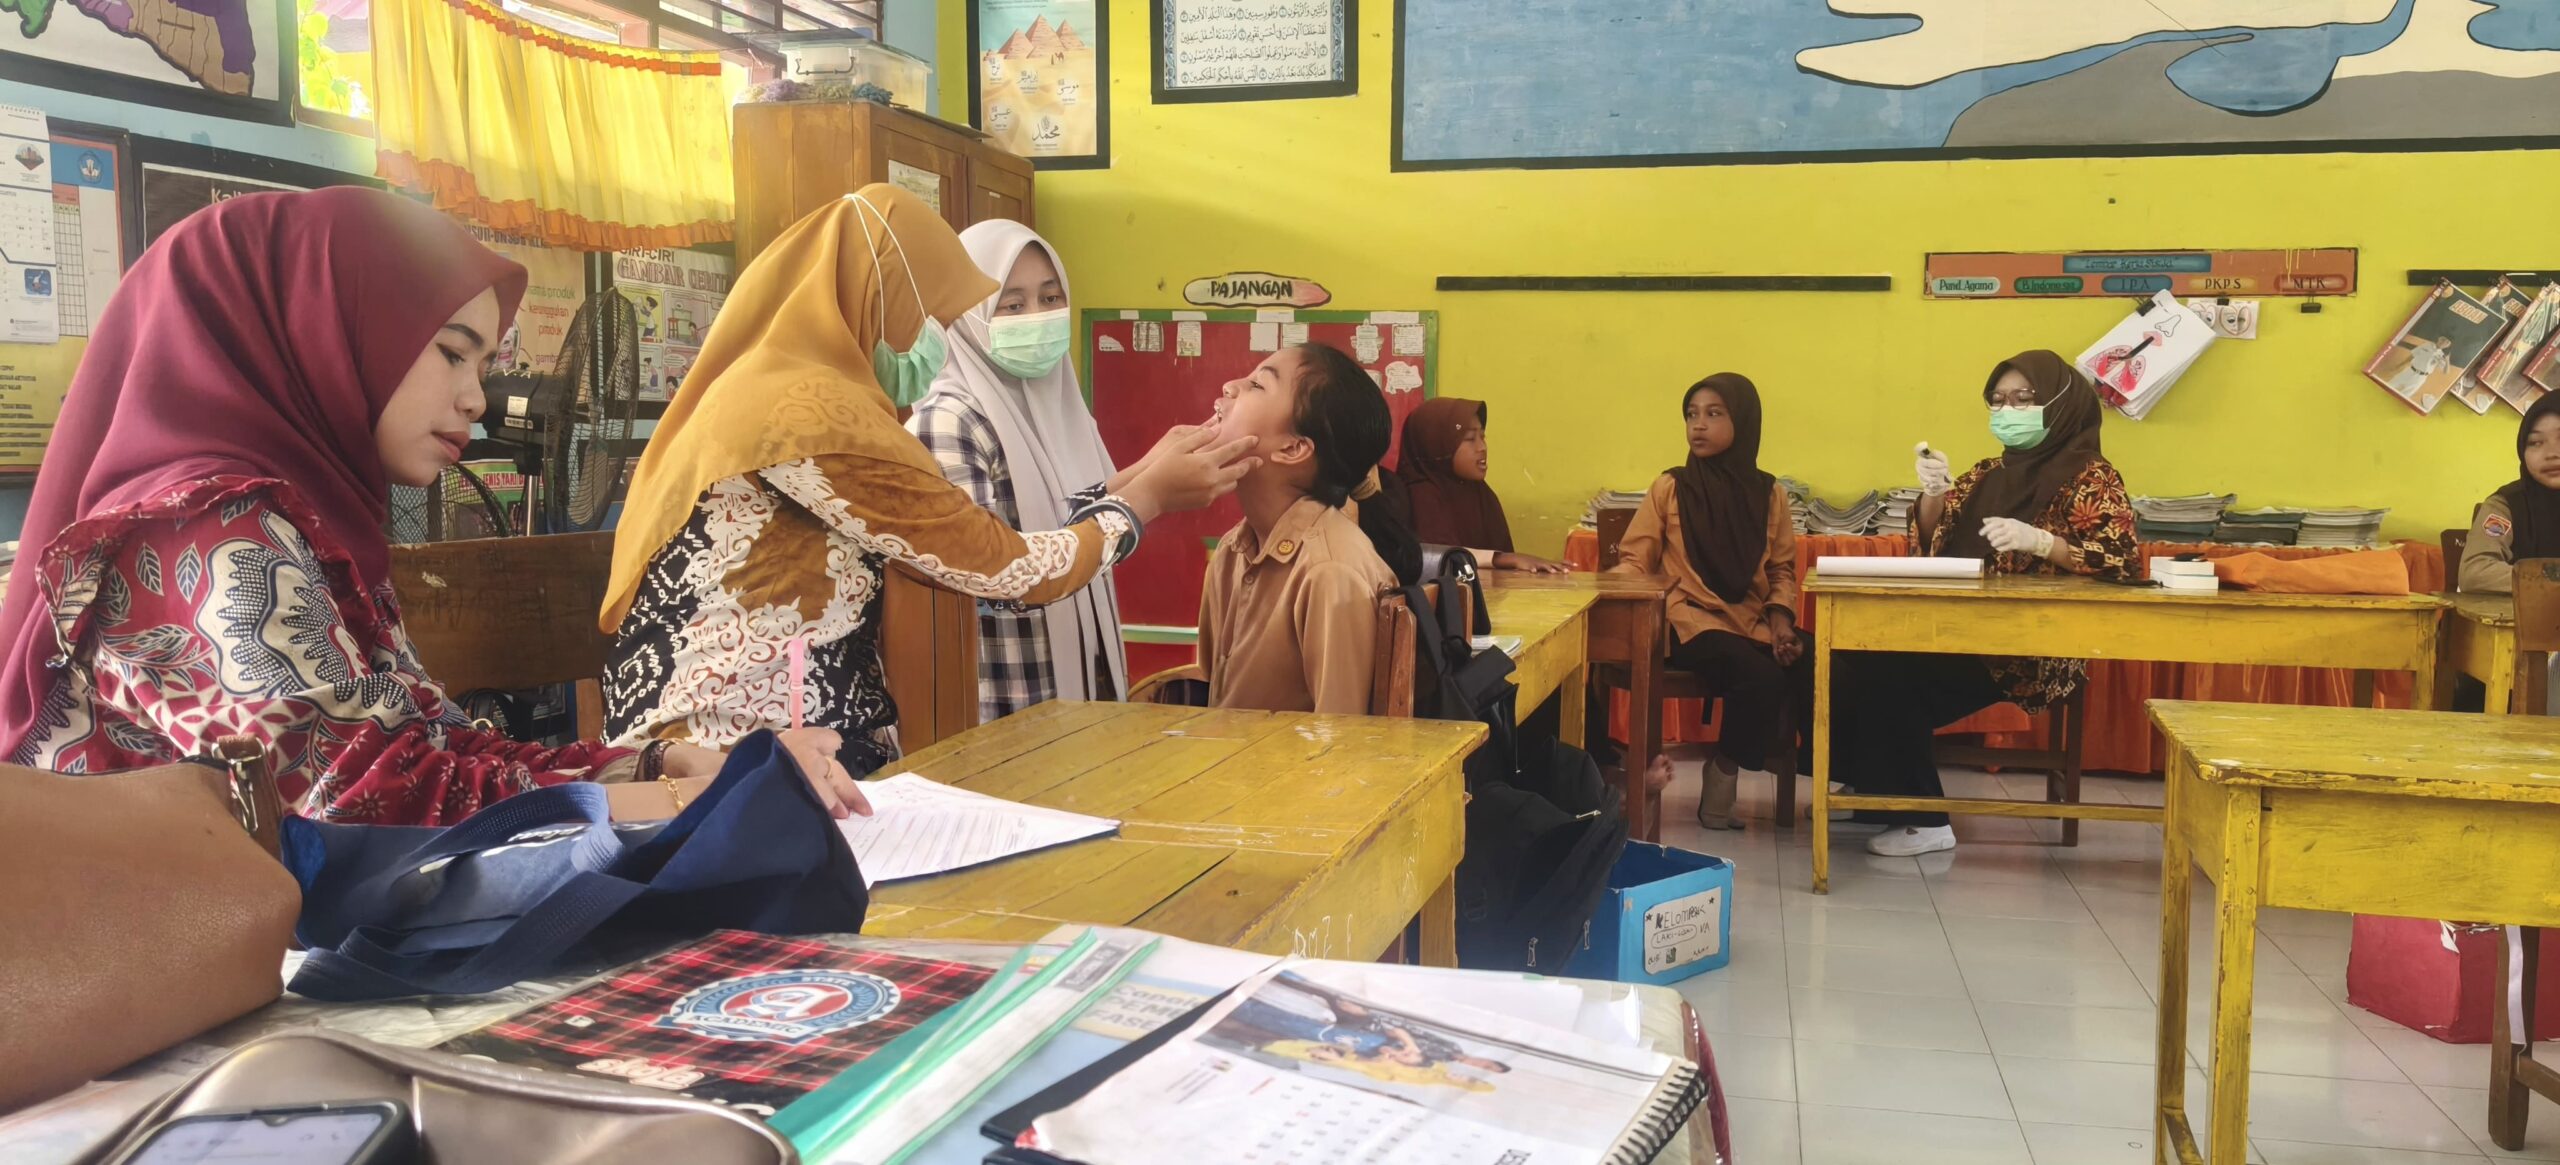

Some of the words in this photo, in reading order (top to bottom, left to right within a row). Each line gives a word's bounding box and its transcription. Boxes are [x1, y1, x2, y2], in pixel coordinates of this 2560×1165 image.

[617, 257, 686, 288] GAMBAR
[1211, 280, 1293, 300] PAJANGAN
[2293, 278, 2326, 290] MTK
[690, 1015, 803, 1035] ACADEMIC
